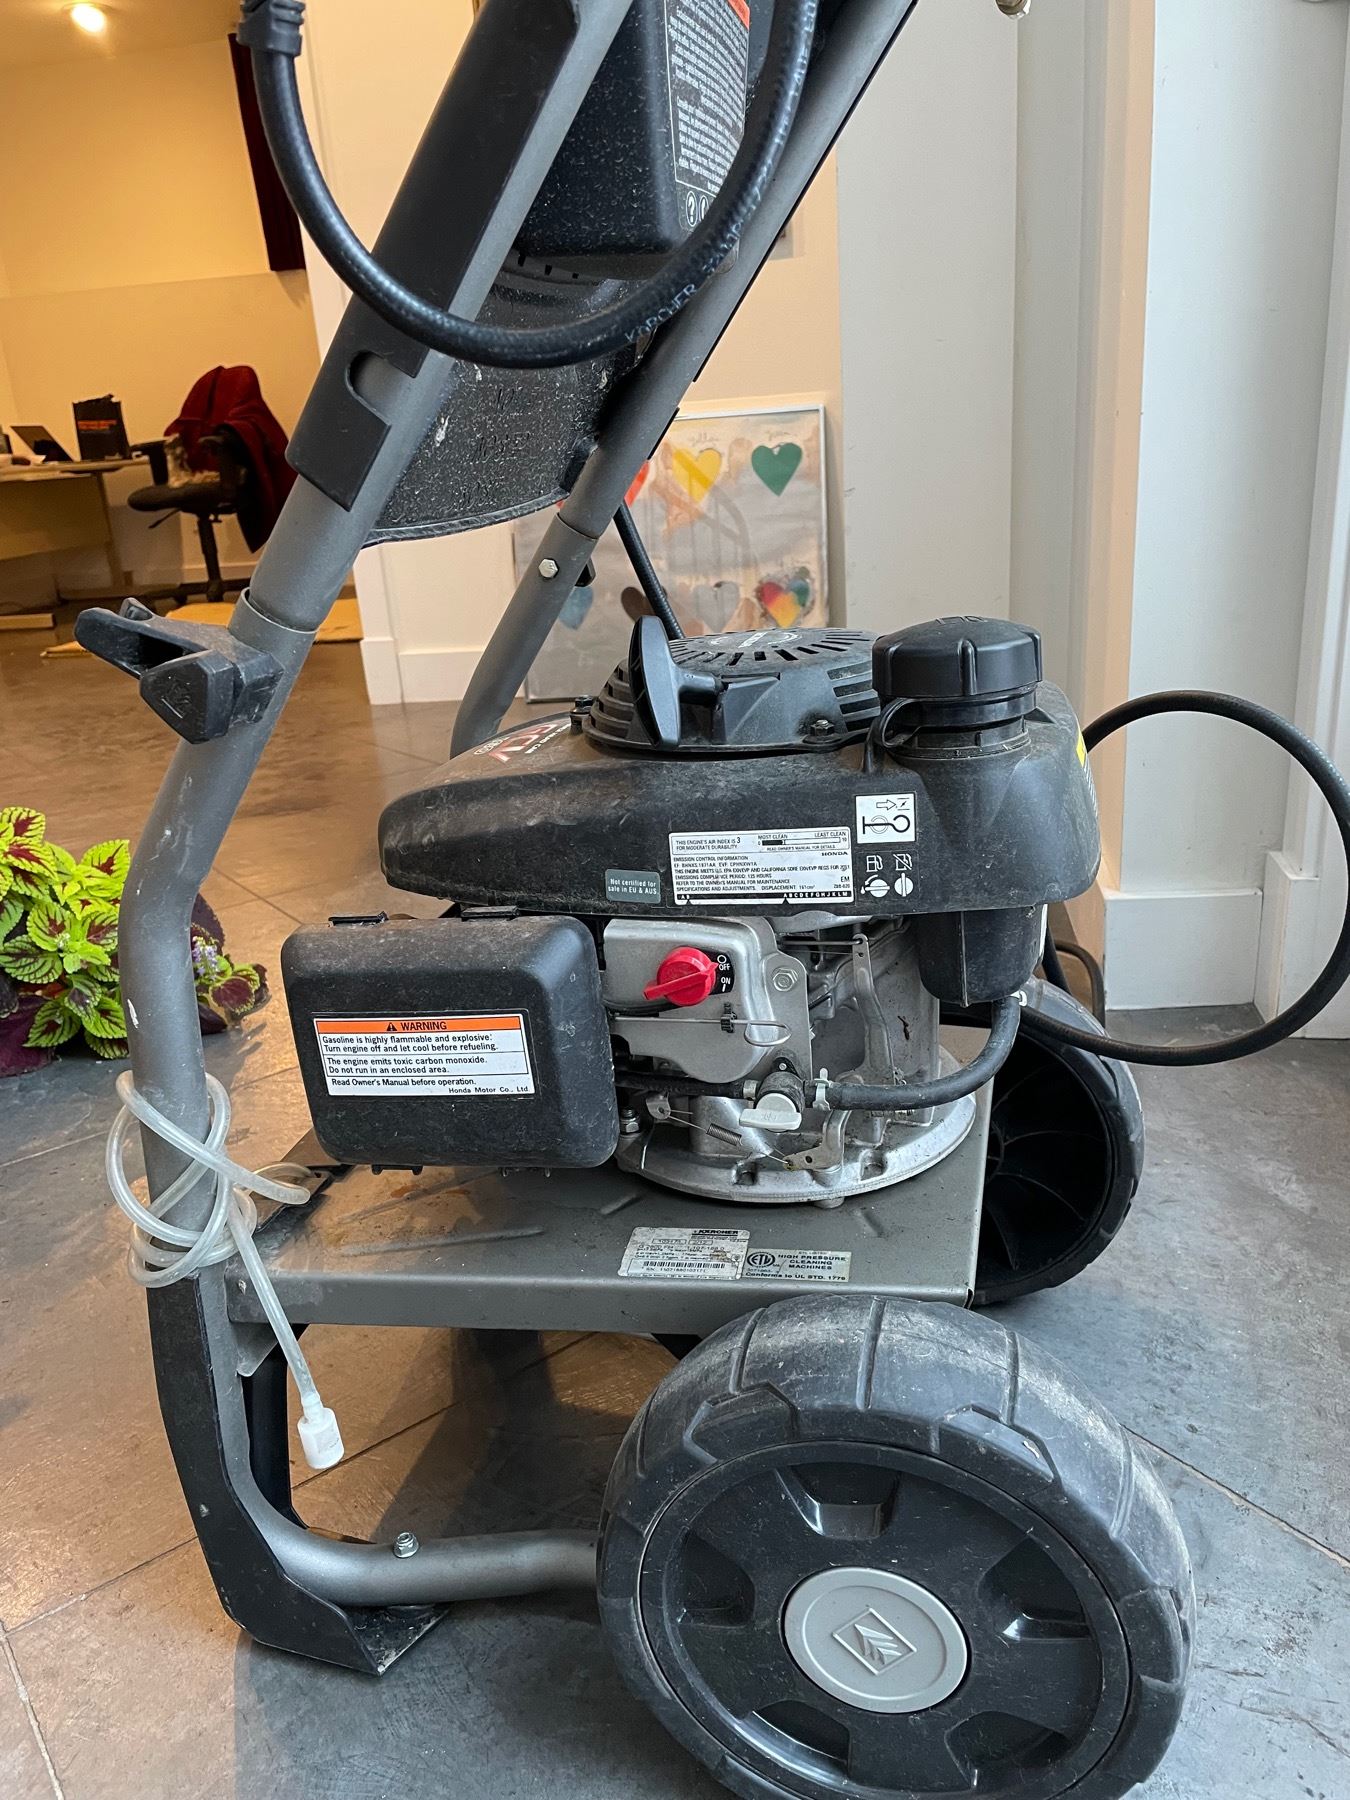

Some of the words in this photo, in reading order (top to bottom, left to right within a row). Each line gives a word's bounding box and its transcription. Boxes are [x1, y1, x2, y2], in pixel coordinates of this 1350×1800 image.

[401, 1021, 447, 1031] WARNING
[365, 1035, 388, 1044] highly
[390, 1034, 432, 1043] flammable
[452, 1033, 492, 1043] explosive:
[343, 1045, 368, 1053] engine
[460, 1043, 498, 1051] refueling.
[344, 1058, 368, 1066] engine
[438, 1078, 476, 1086] operation.
[752, 1254, 772, 1265] ETL
